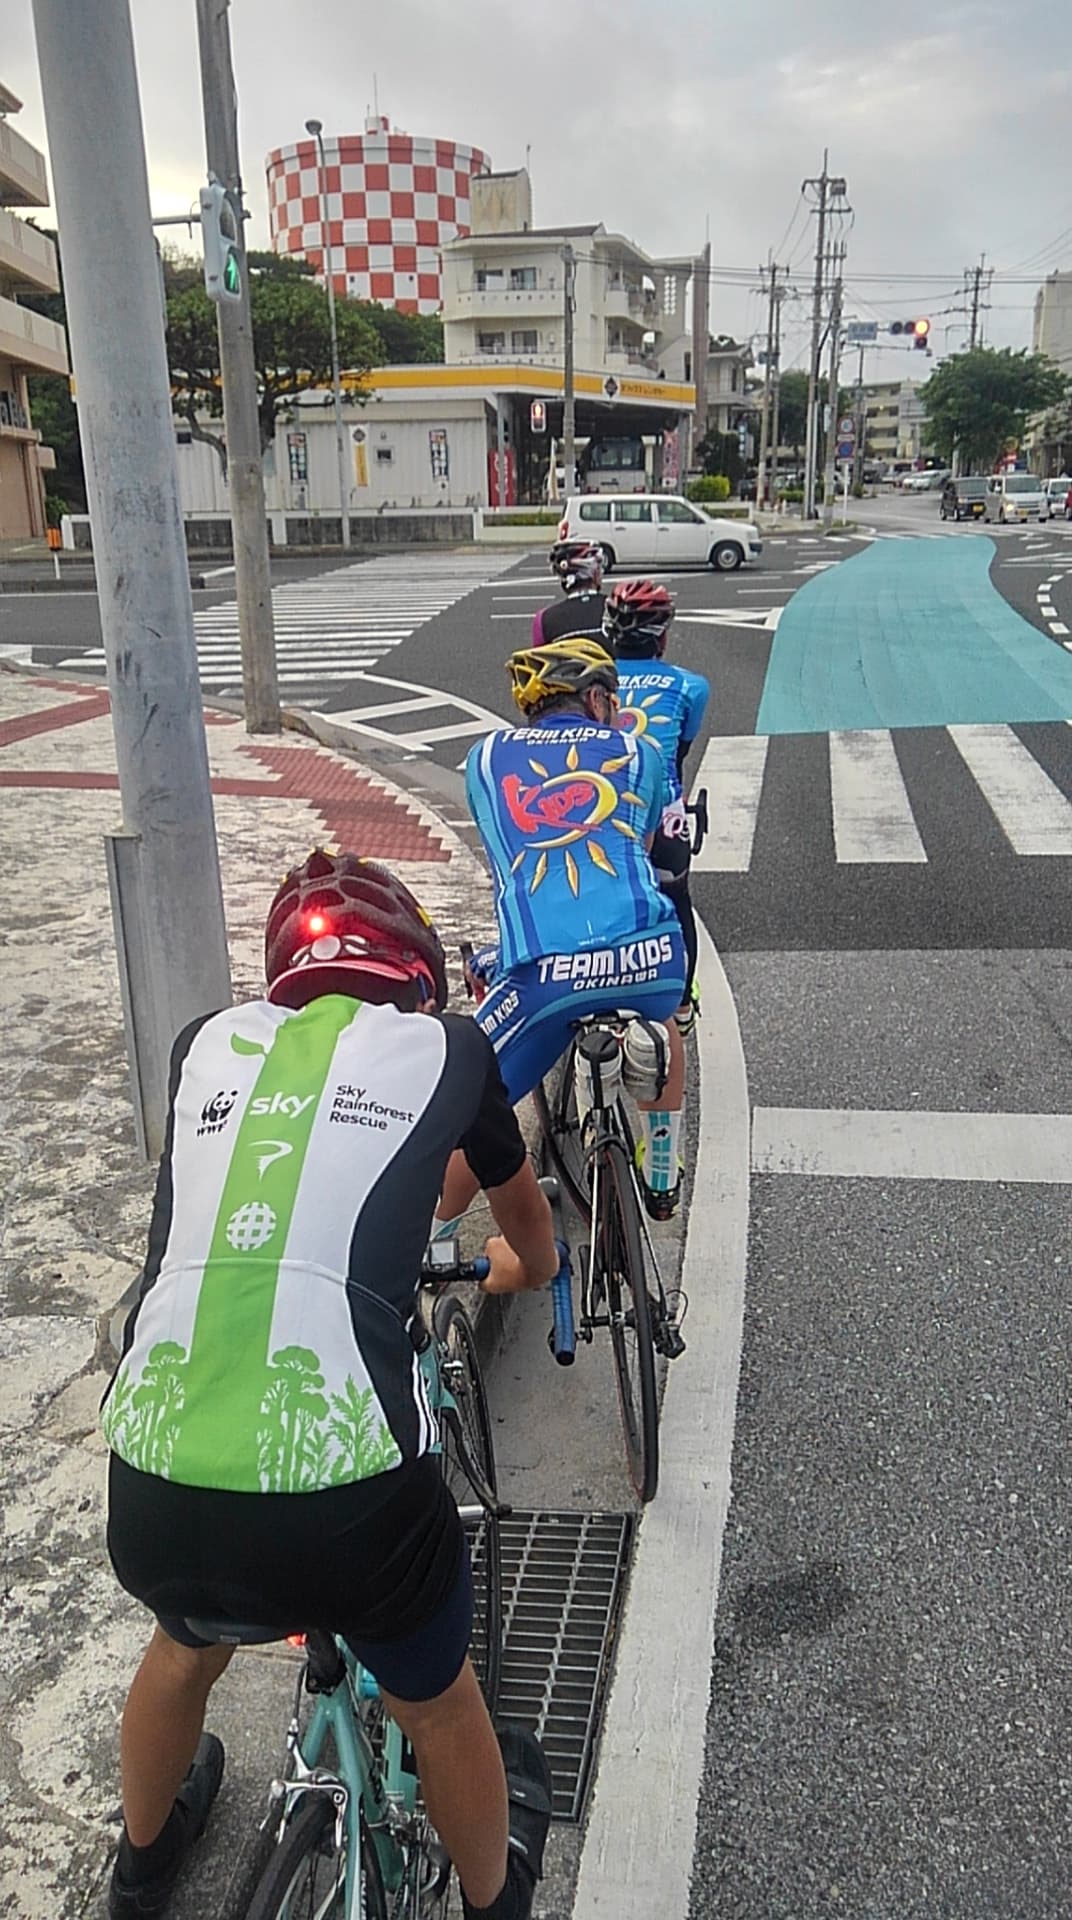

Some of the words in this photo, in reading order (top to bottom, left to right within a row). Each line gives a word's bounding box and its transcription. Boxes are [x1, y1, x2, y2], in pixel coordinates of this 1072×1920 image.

[628, 674, 676, 689] KIDS
[501, 727, 559, 743] TEAM
[560, 726, 612, 741] KIDS
[537, 949, 614, 984] TEAM
[620, 934, 673, 973] KIDS
[573, 968, 658, 991] OKINAWA
[493, 989, 520, 1025] KIDS
[335, 1084, 367, 1099] Sky
[249, 1091, 316, 1119] sky
[332, 1098, 416, 1124] Rainforest
[329, 1110, 388, 1132] Rescue
